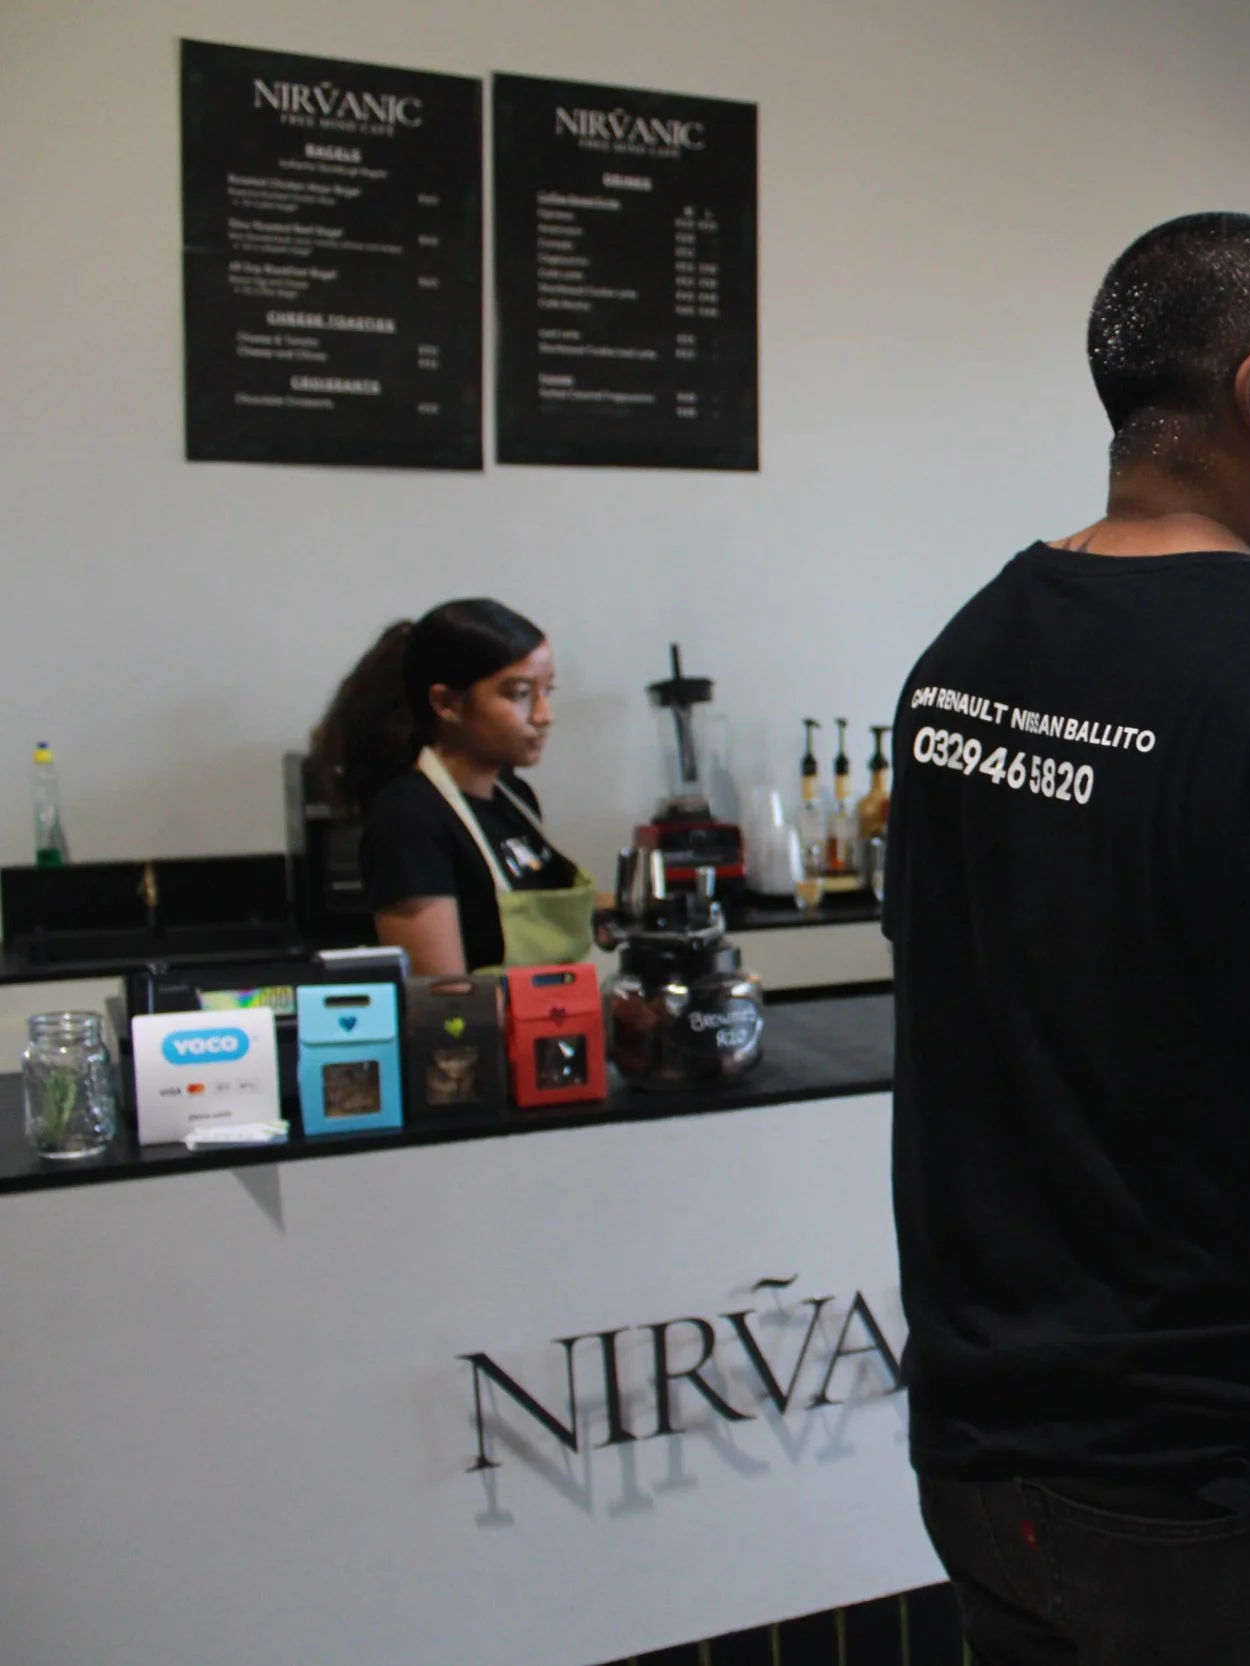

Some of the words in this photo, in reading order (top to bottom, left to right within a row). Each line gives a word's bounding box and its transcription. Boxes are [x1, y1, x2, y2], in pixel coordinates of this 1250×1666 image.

[936, 688, 1009, 725] RENAULT
[1010, 707, 1065, 738] NISSAN
[1063, 718, 1156, 753] BALLITO
